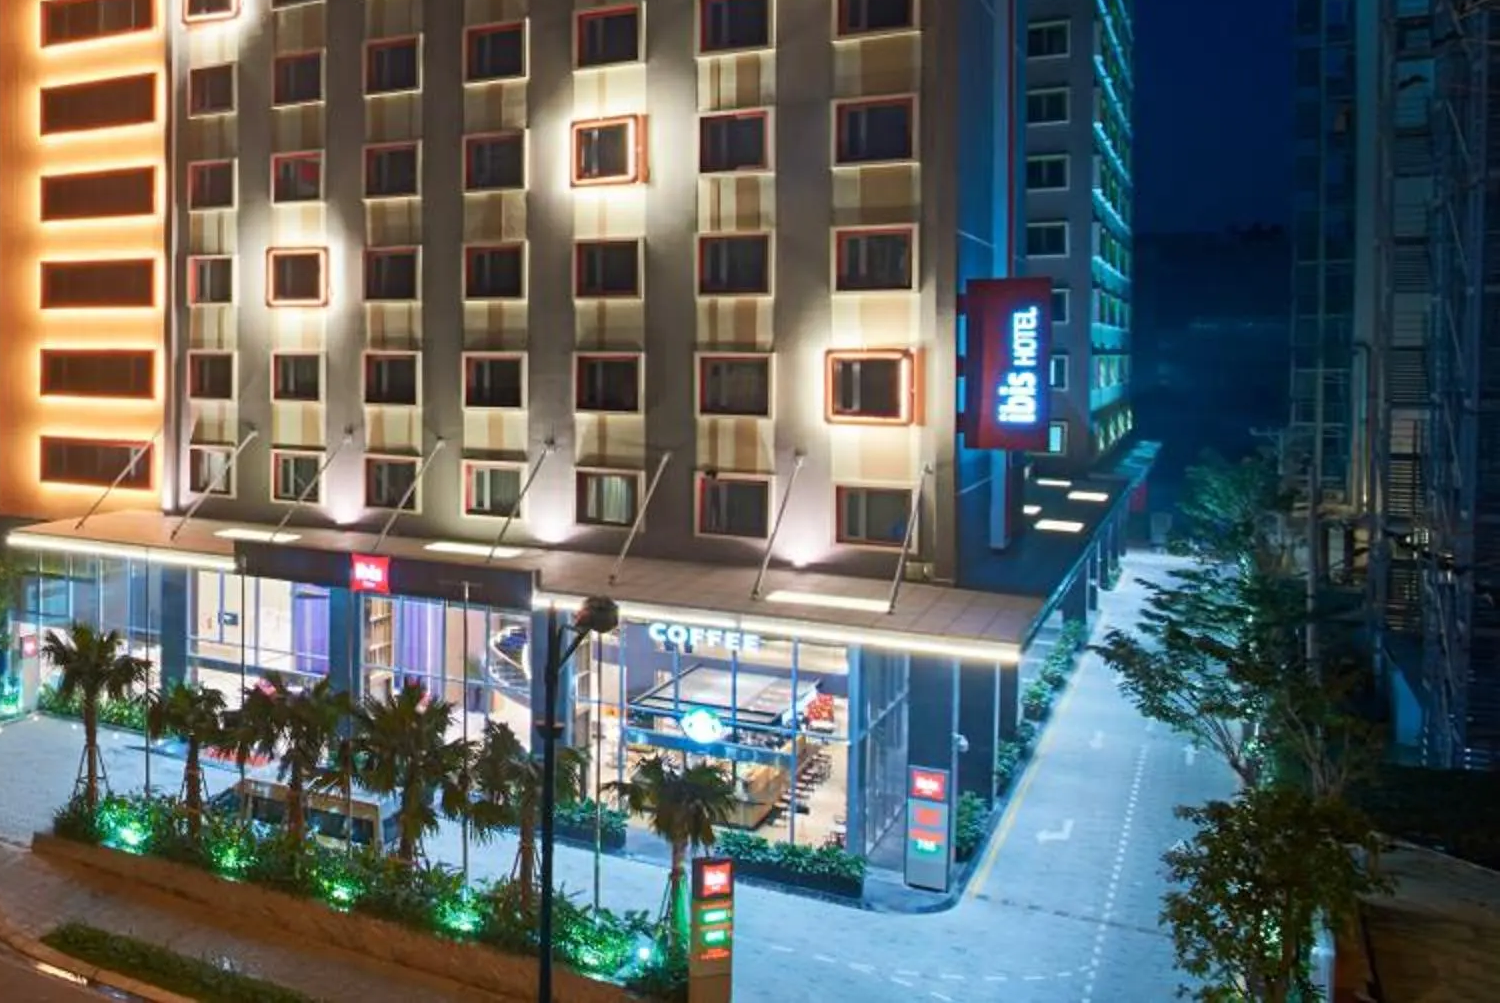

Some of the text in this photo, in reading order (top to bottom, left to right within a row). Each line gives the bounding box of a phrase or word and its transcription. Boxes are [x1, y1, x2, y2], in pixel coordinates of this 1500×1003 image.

[998, 305, 1038, 422] ibis HOTEL
[648, 622, 761, 652] COFFEE
